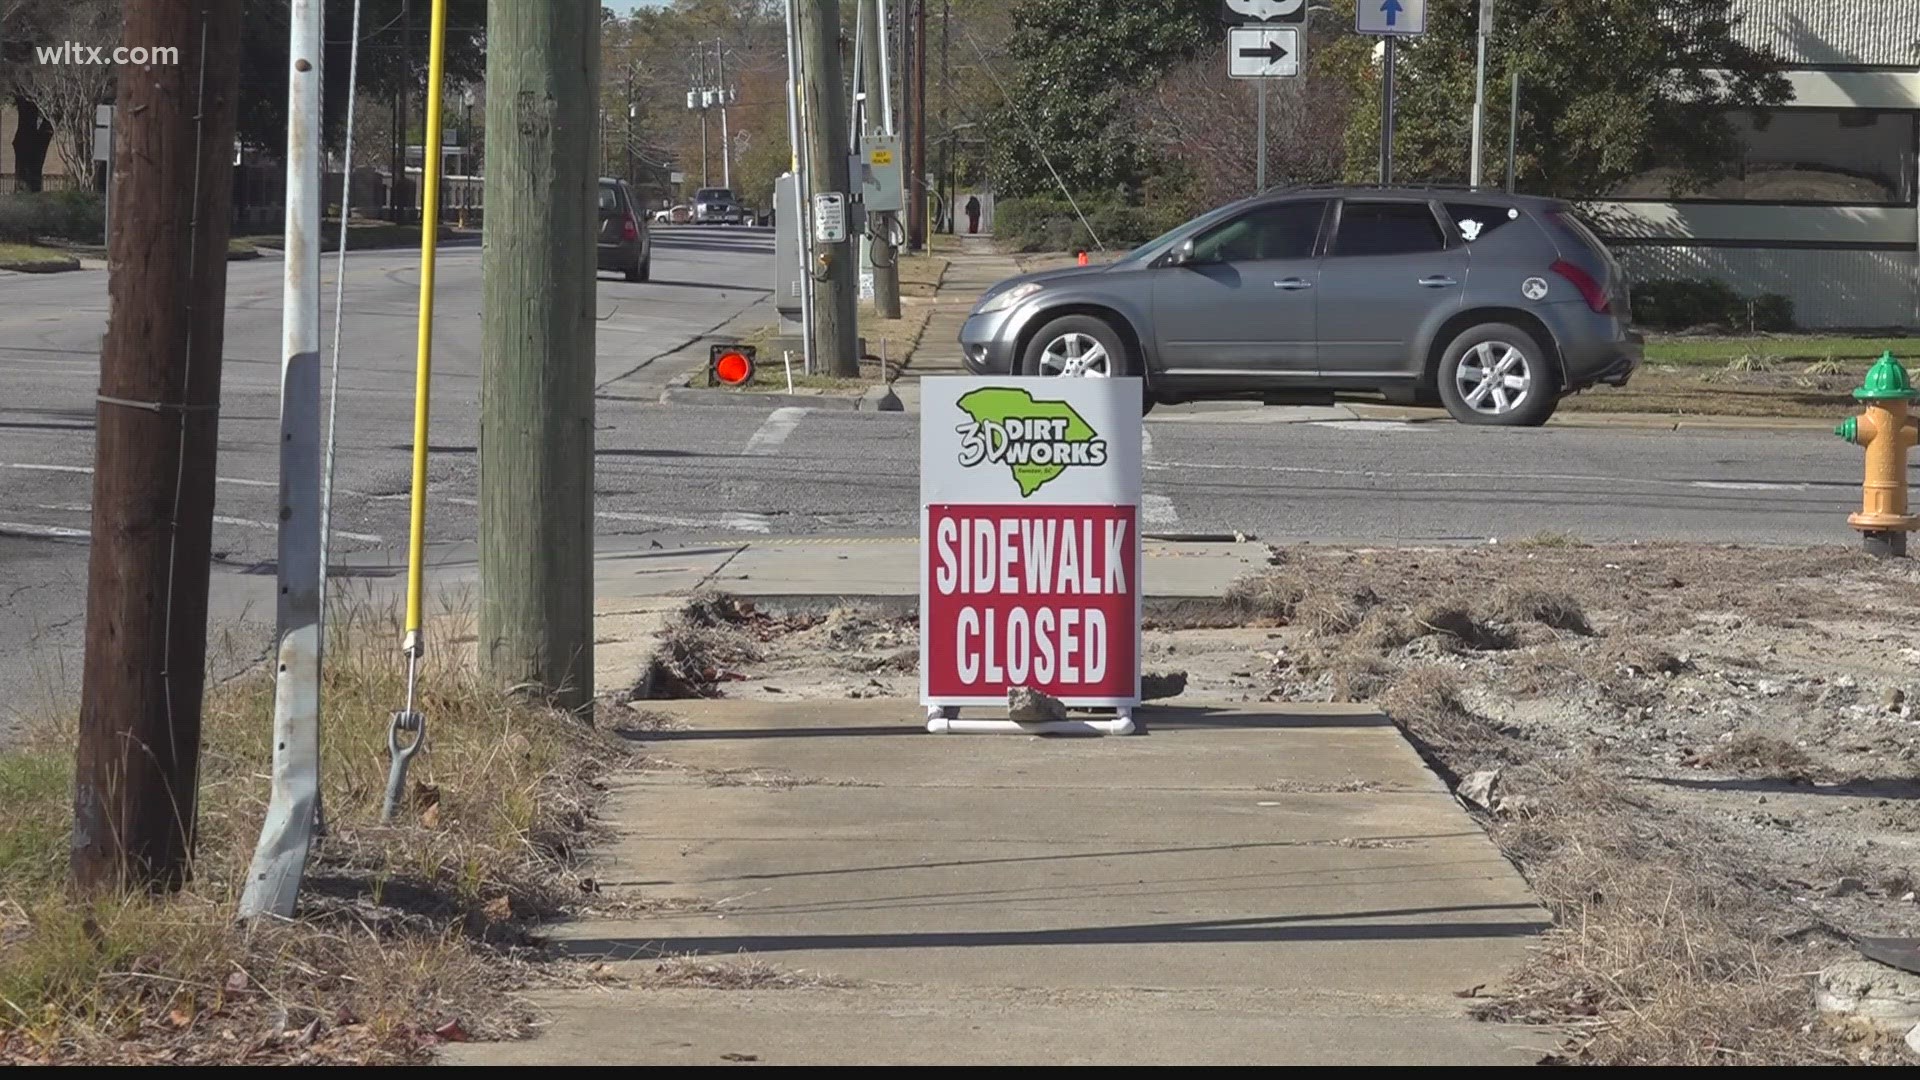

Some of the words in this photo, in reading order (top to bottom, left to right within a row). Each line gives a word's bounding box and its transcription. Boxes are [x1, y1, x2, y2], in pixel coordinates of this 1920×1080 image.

[956, 418, 1009, 467] 3D
[1003, 417, 1069, 441] DIRT
[1005, 441, 1107, 465] WORKS
[937, 517, 1127, 595] SIDEWALK
[957, 606, 1107, 685] CLOSED
